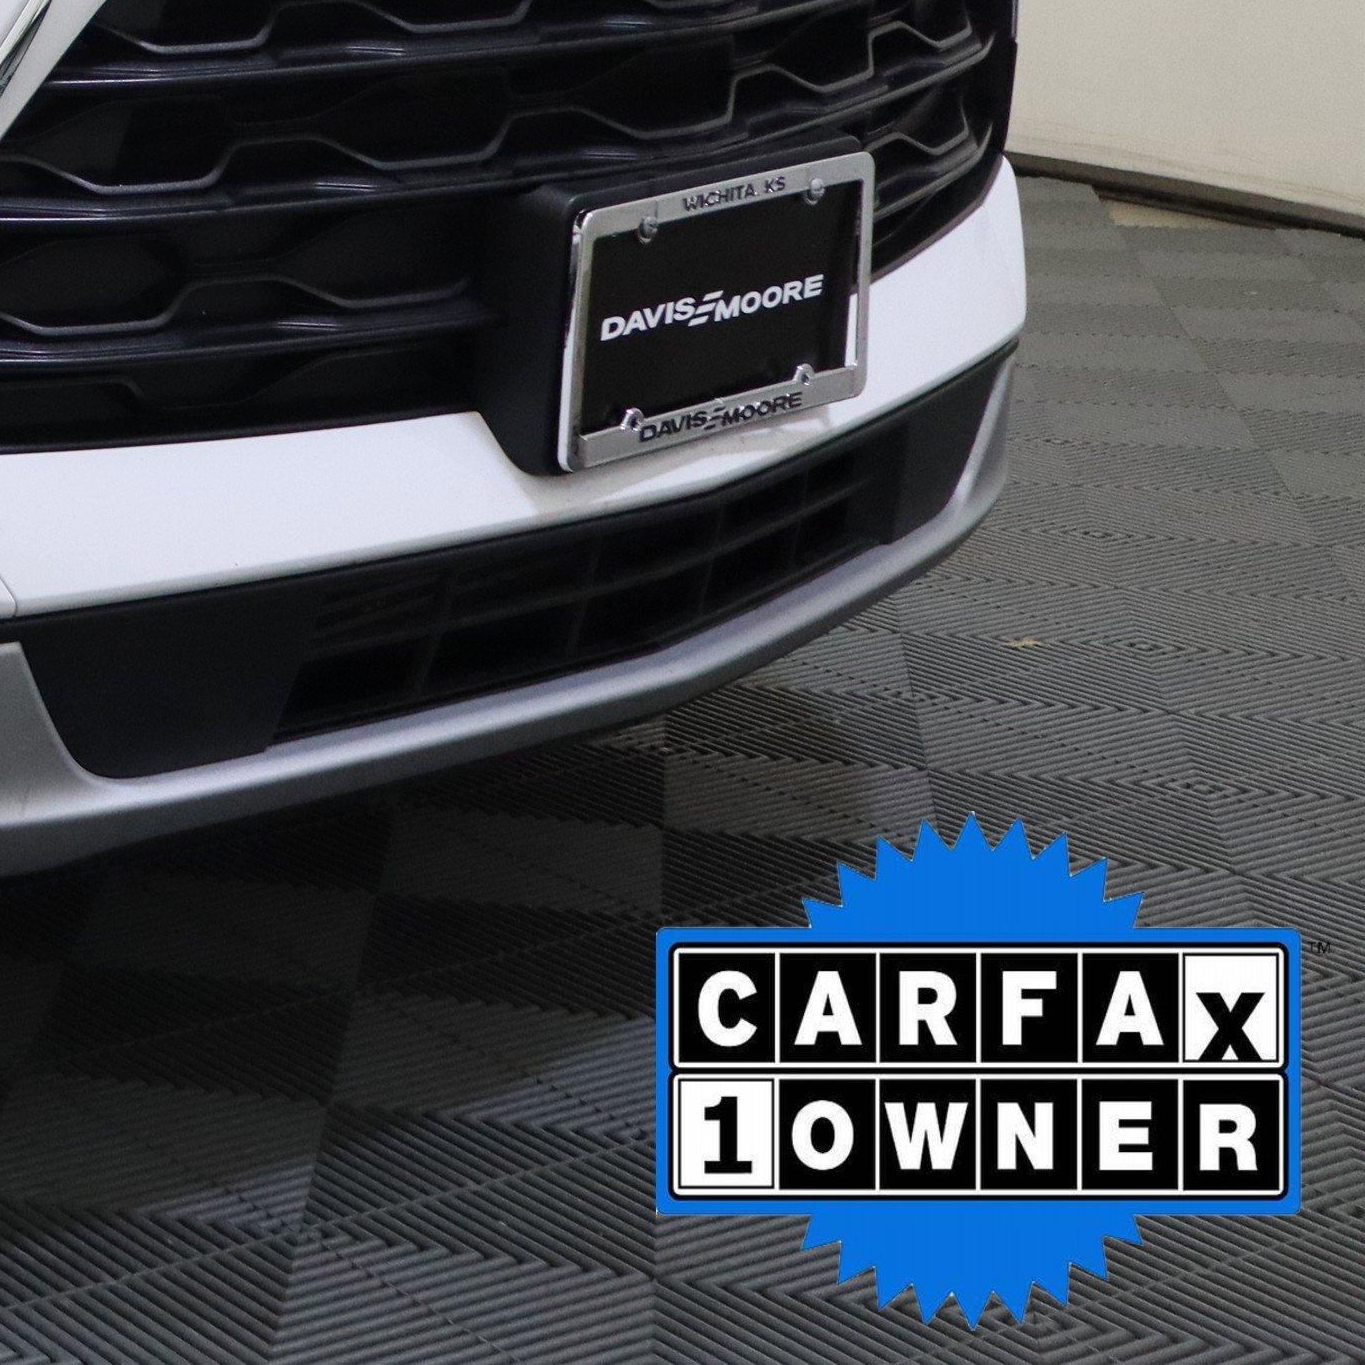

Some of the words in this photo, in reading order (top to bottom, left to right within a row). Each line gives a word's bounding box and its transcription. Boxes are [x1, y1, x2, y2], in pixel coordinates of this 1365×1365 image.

[764, 176, 787, 194] KS
[600, 297, 696, 341] DAVIS
[714, 274, 824, 322] MOORE
[640, 410, 707, 442] DAVIS
[722, 391, 803, 427] MOORE
